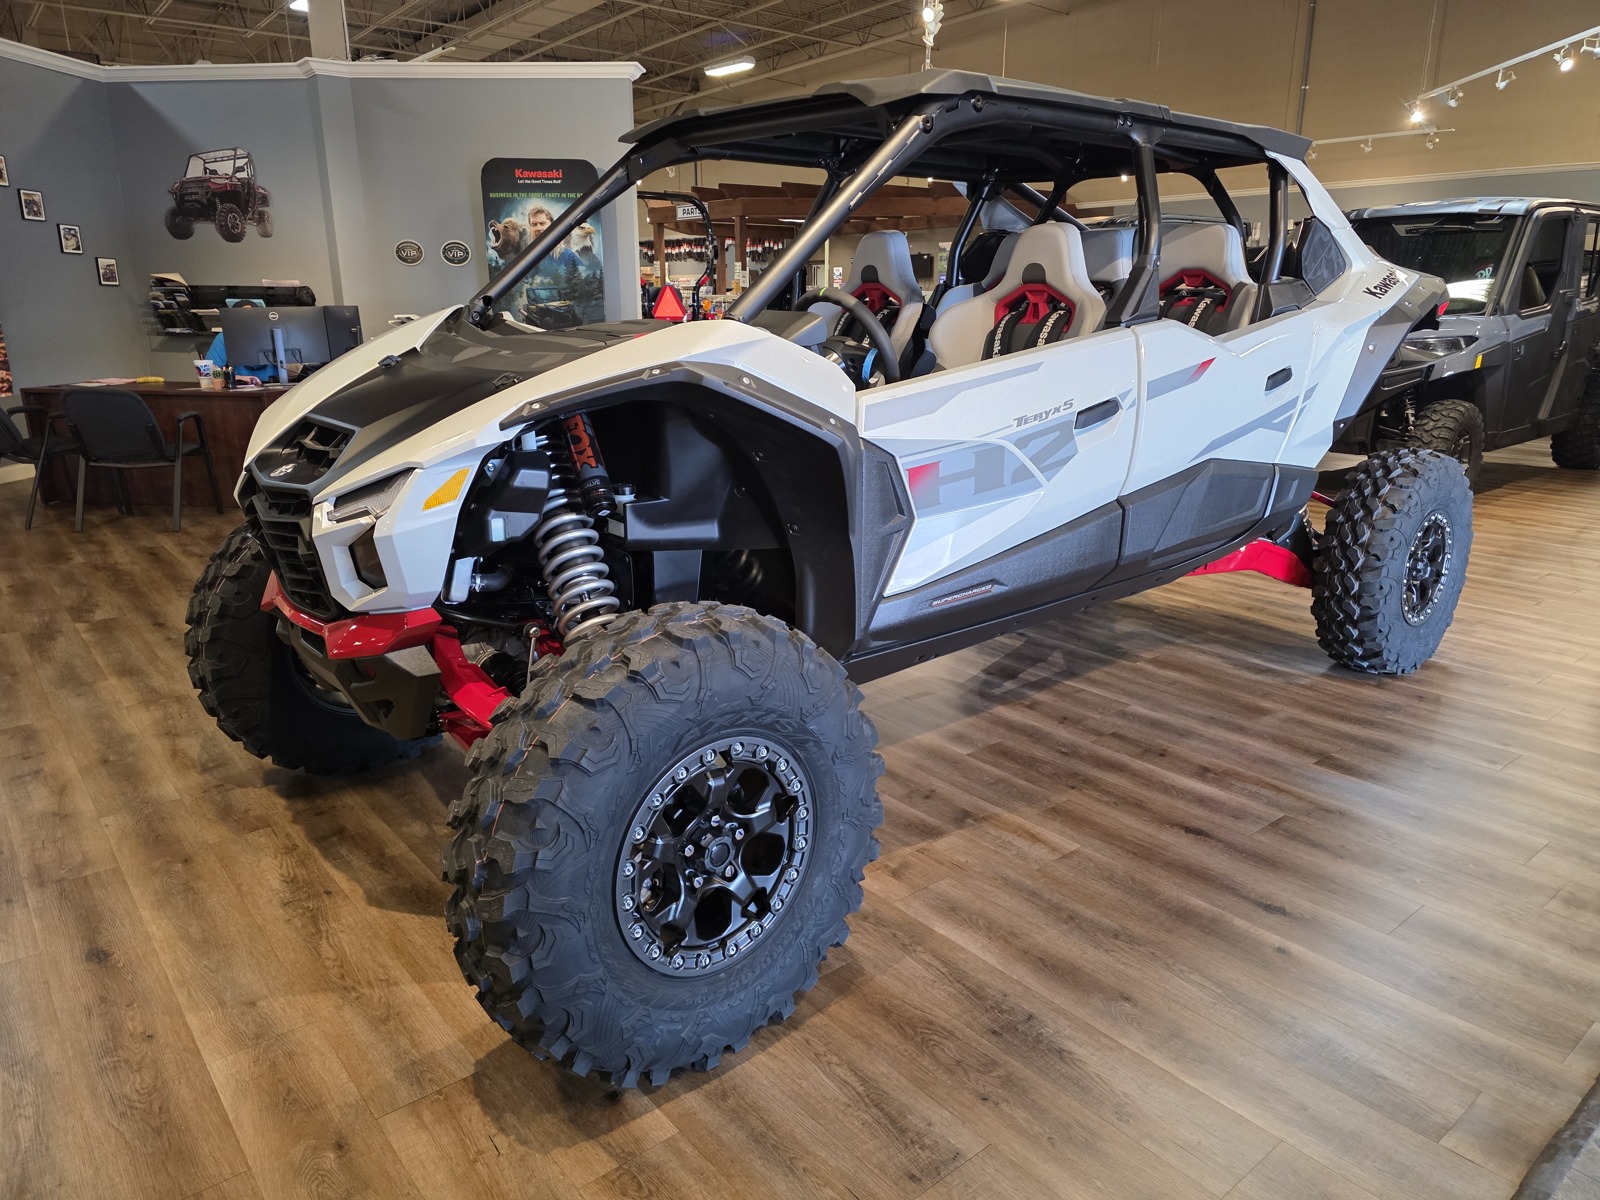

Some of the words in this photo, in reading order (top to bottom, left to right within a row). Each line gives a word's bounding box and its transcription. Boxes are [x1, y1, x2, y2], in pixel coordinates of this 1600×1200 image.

[515, 168, 562, 178] Kawasaki
[1037, 310, 1066, 347] Kawasa
[1188, 297, 1213, 328] Kawas
[563, 413, 598, 472] FOX
[905, 419, 1078, 511] H2
[932, 584, 992, 606] SUPERCHARGED
